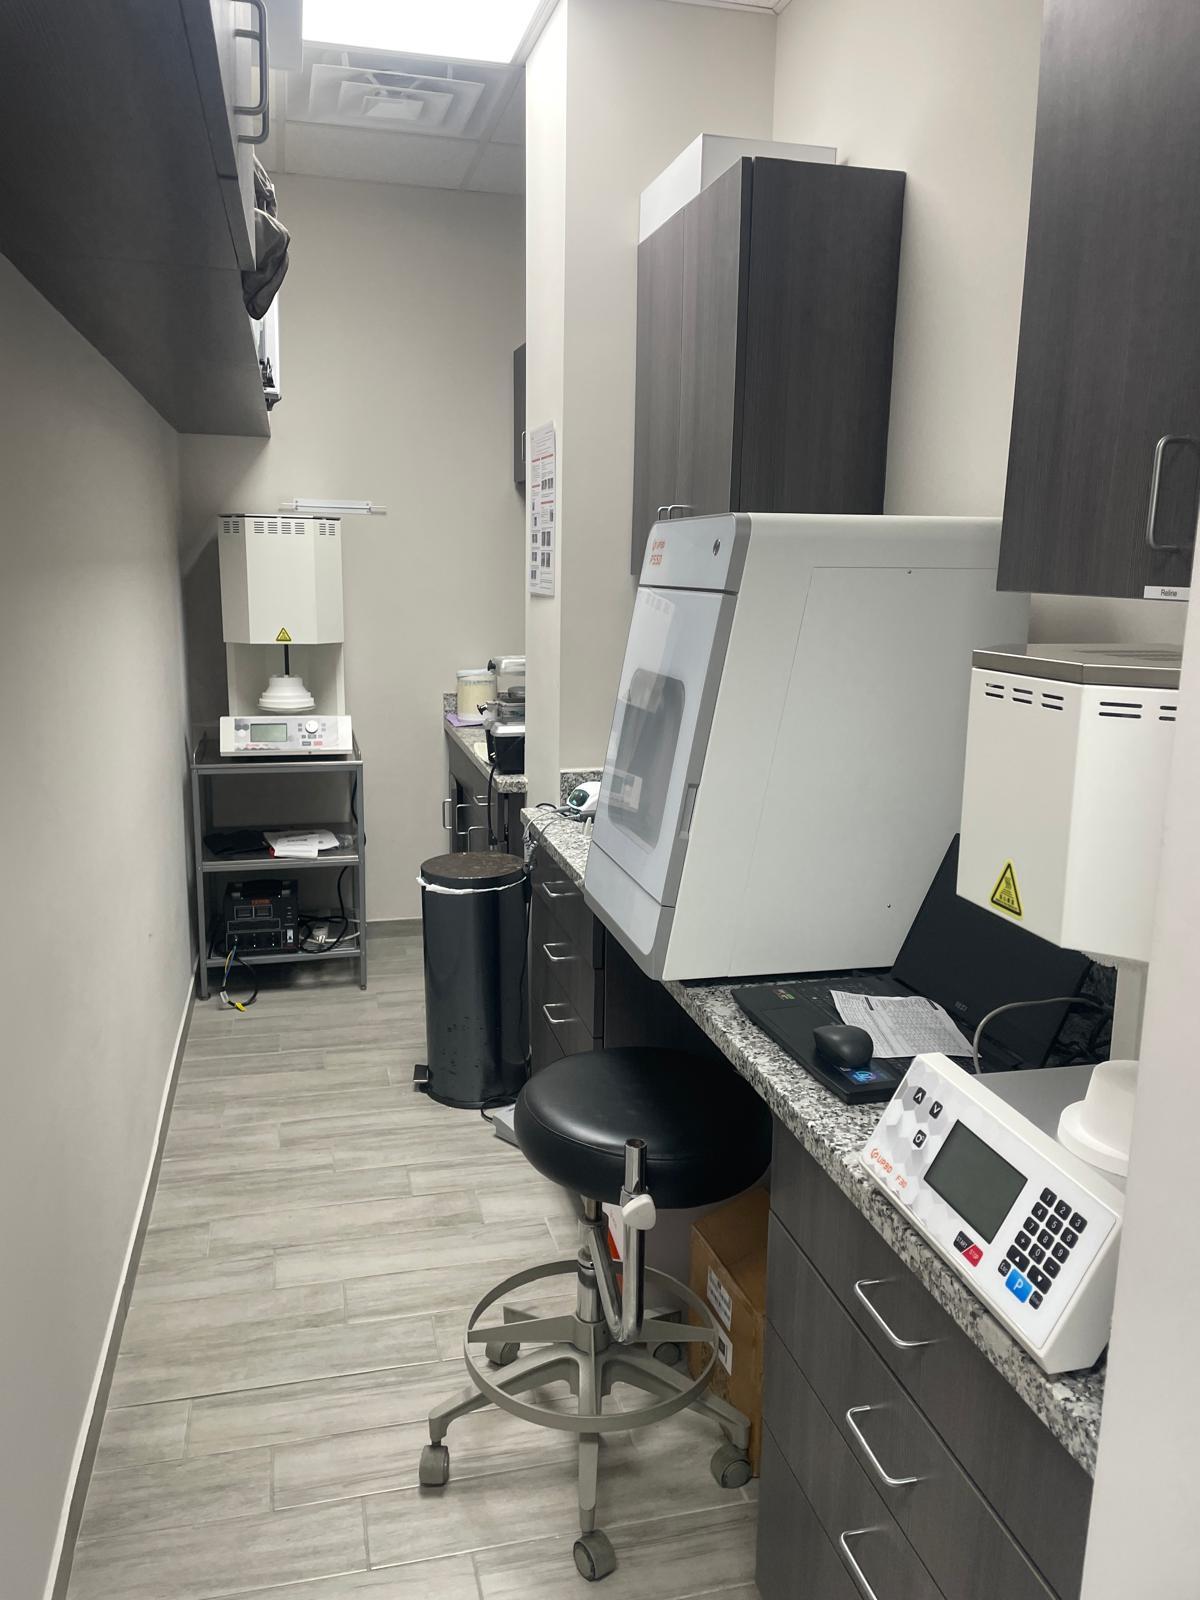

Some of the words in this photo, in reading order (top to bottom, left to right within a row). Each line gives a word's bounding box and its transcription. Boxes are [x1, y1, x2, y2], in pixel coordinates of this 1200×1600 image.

[1160, 589, 1178, 597] Reline
[1037, 1208, 1043, 1216] 4
[1060, 1206, 1066, 1215] 2
[1051, 1221, 1058, 1229] 5
[1075, 1219, 1081, 1228] 3
[1043, 1235, 1049, 1244] 8
[1057, 1249, 1064, 1257] 9
[1013, 1278, 1024, 1291] P
